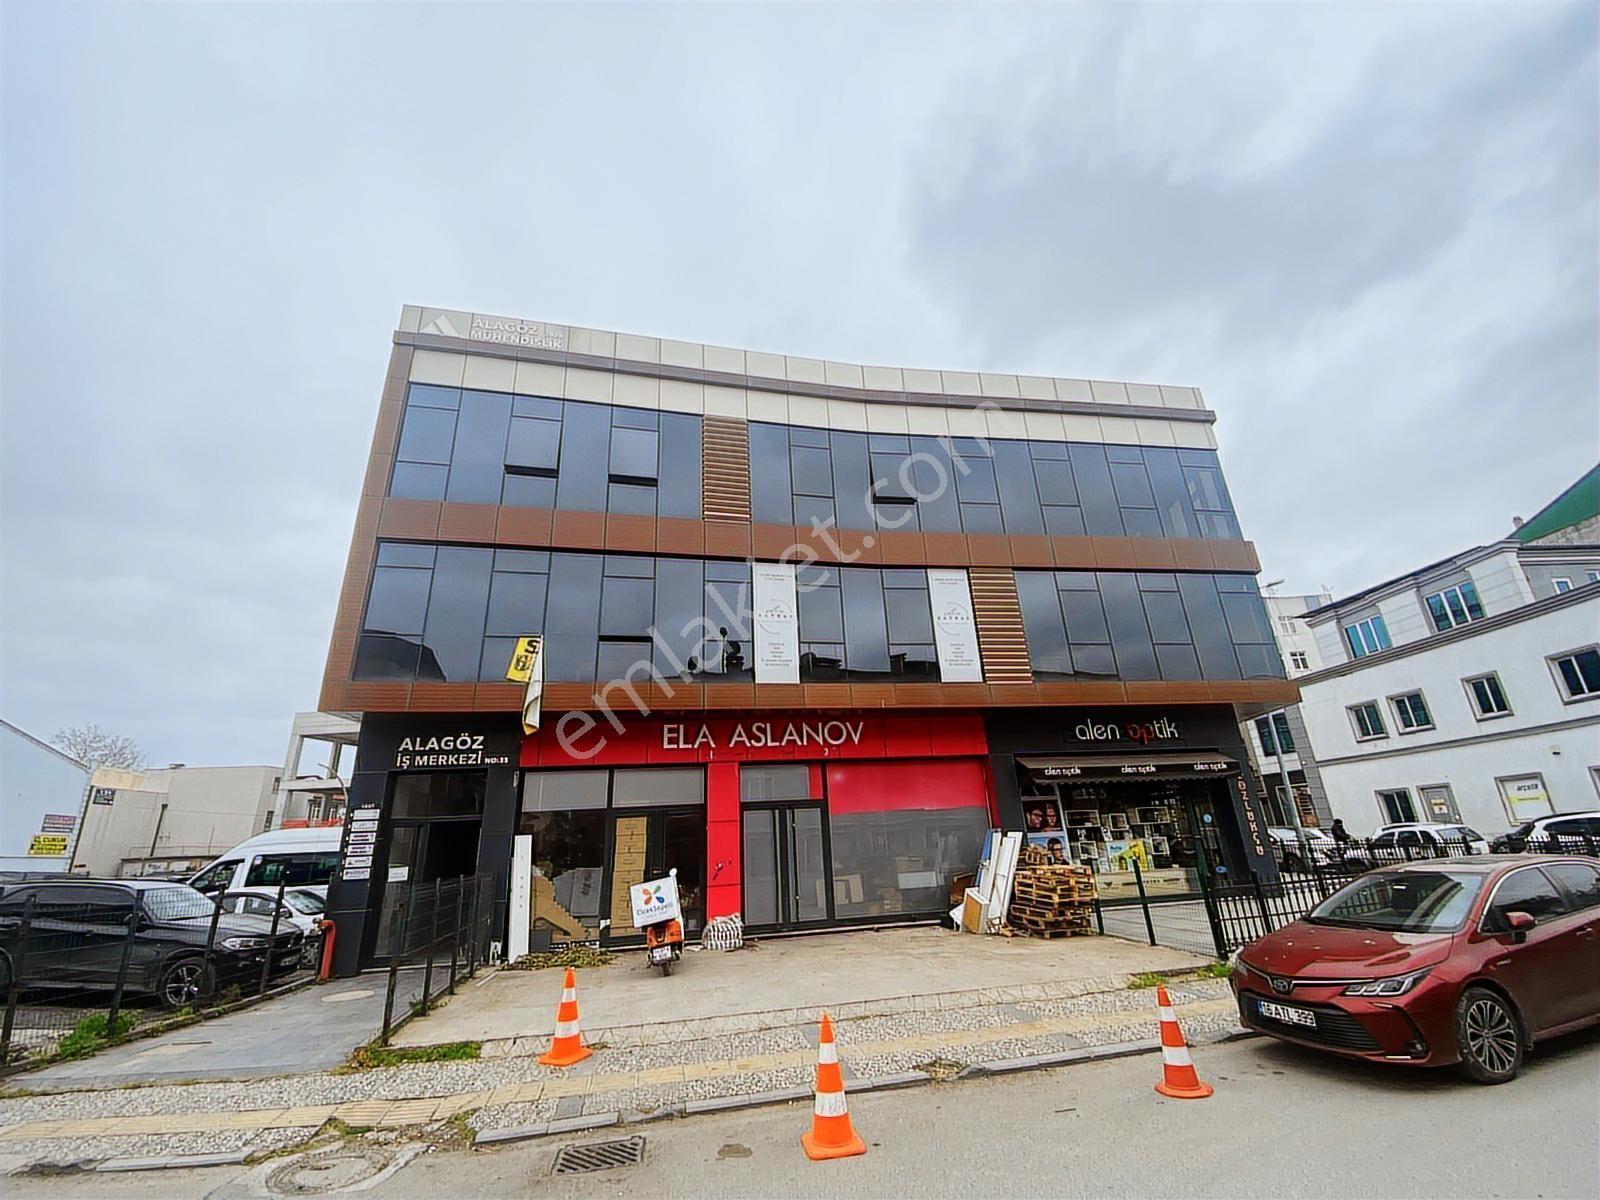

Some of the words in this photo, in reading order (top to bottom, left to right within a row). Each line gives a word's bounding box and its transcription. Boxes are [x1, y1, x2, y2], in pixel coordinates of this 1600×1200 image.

[398, 732, 485, 751] ALAGÖZ
[663, 723, 716, 749] ELA
[729, 721, 863, 748] ASLANOV
[1075, 718, 1120, 740] alen
[1127, 717, 1179, 745] optik
[396, 753, 410, 769] İŞ
[414, 750, 482, 766] MERKEZİ
